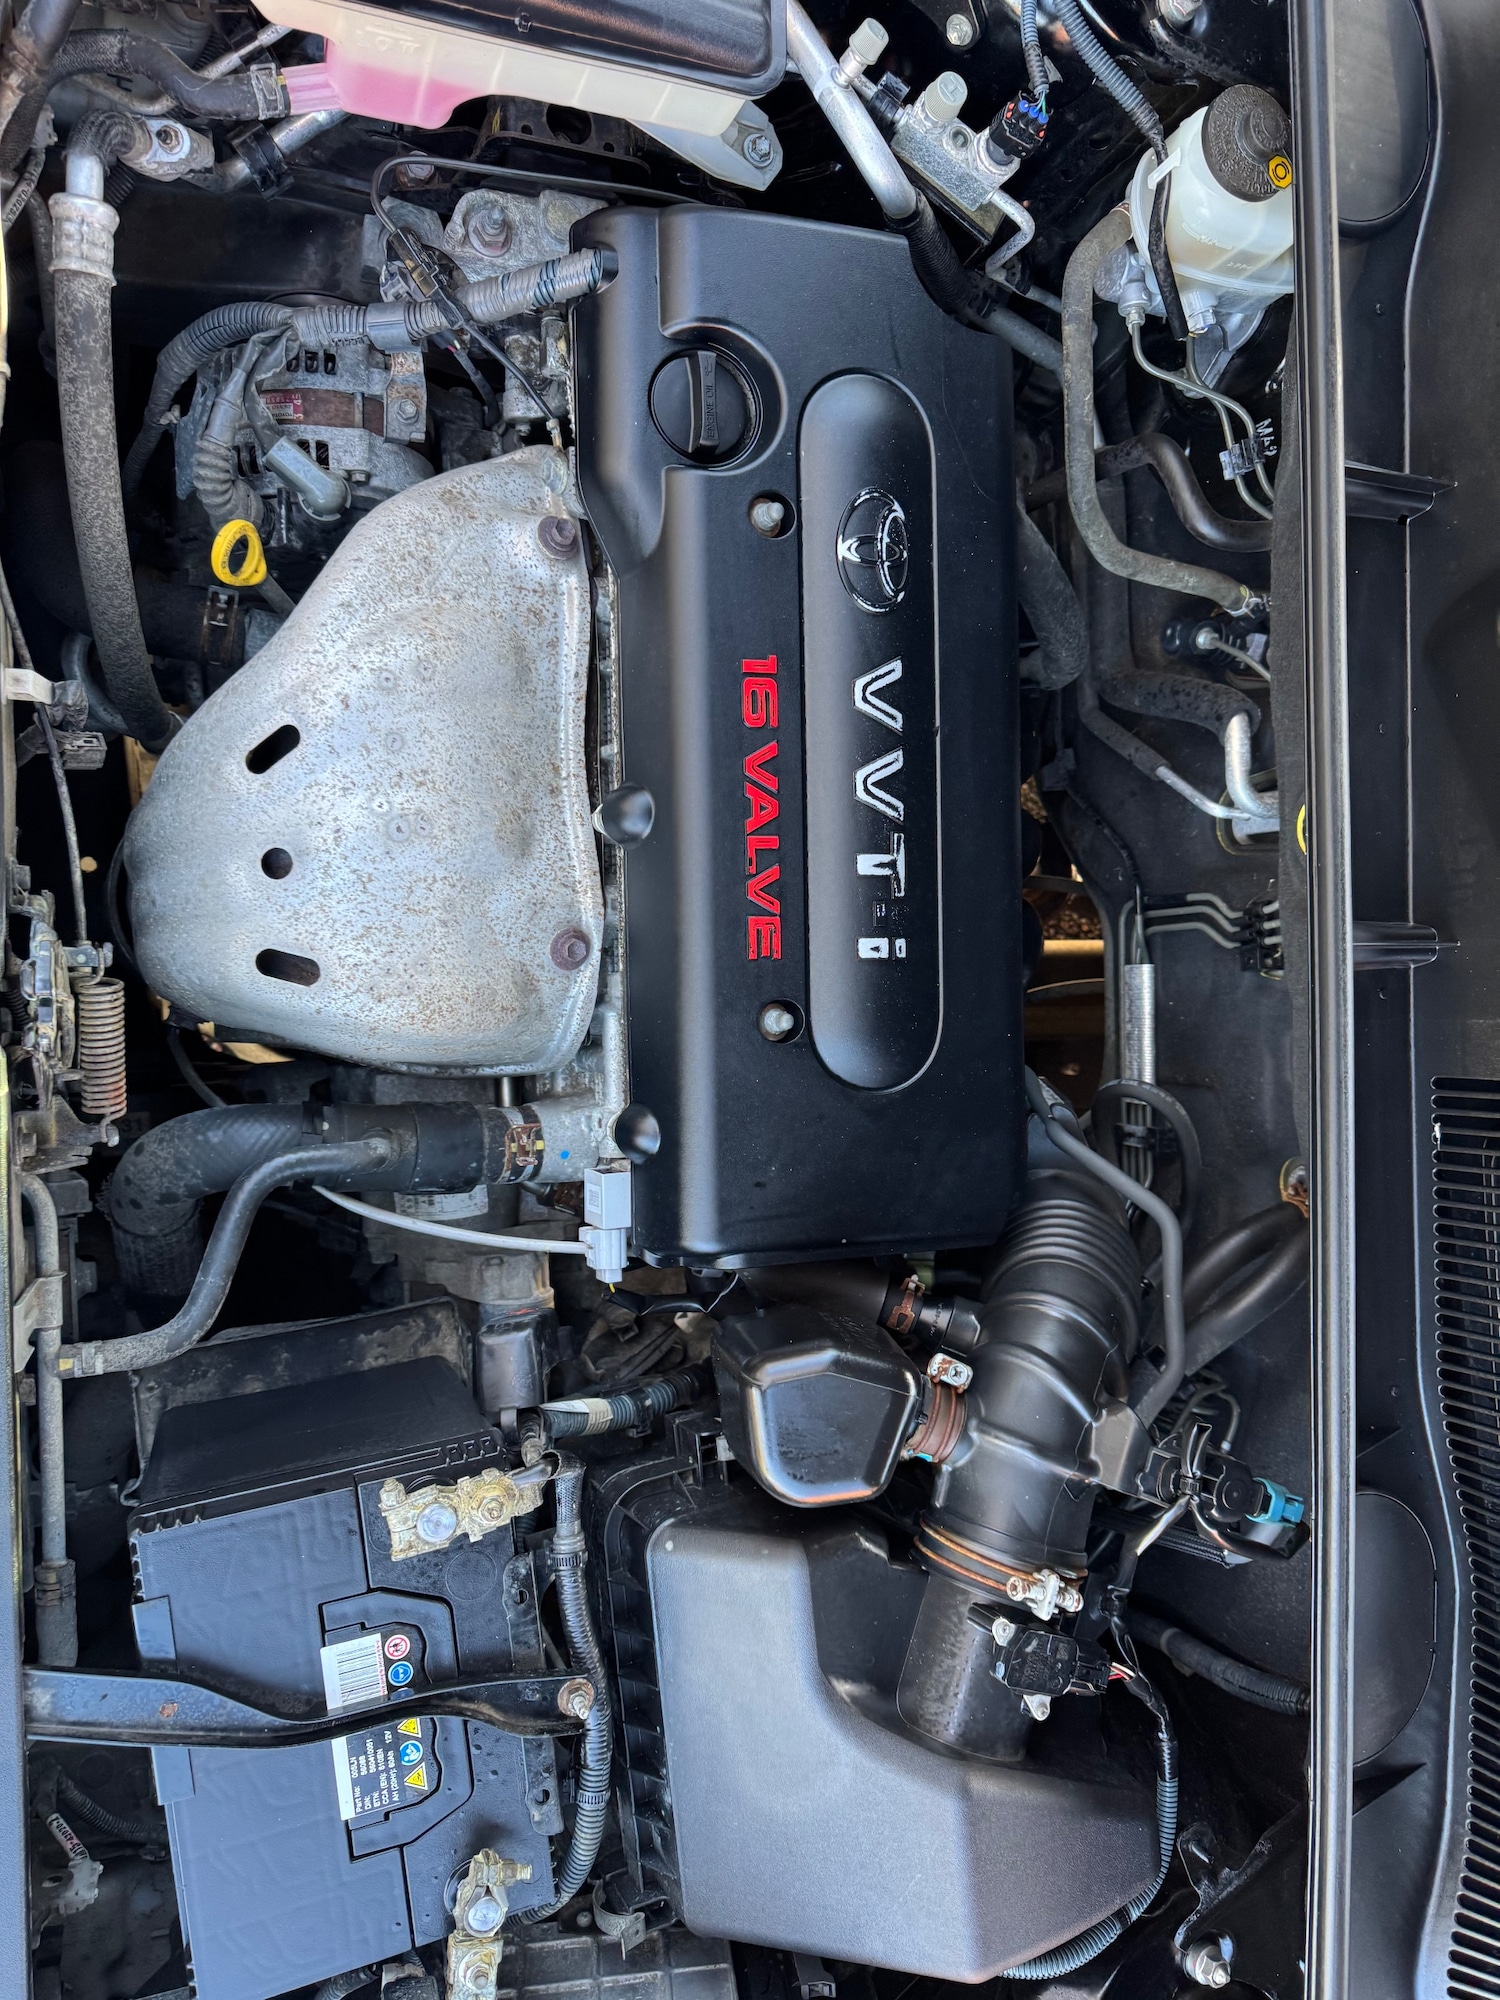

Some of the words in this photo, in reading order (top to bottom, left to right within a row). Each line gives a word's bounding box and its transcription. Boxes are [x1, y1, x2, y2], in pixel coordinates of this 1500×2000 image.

[706, 385, 714, 398] OIL
[706, 401, 715, 437] ENGINE
[741, 654, 780, 729] 16
[744, 740, 782, 960] VALVE
[384, 1730, 392, 1744] 12V
[379, 1772, 387, 1788] (EN):
[389, 1768, 398, 1790] (20Hr):
[372, 1791, 380, 1807] ETN:
[381, 1789, 389, 1804] CCA
[392, 1791, 399, 1801] AH
